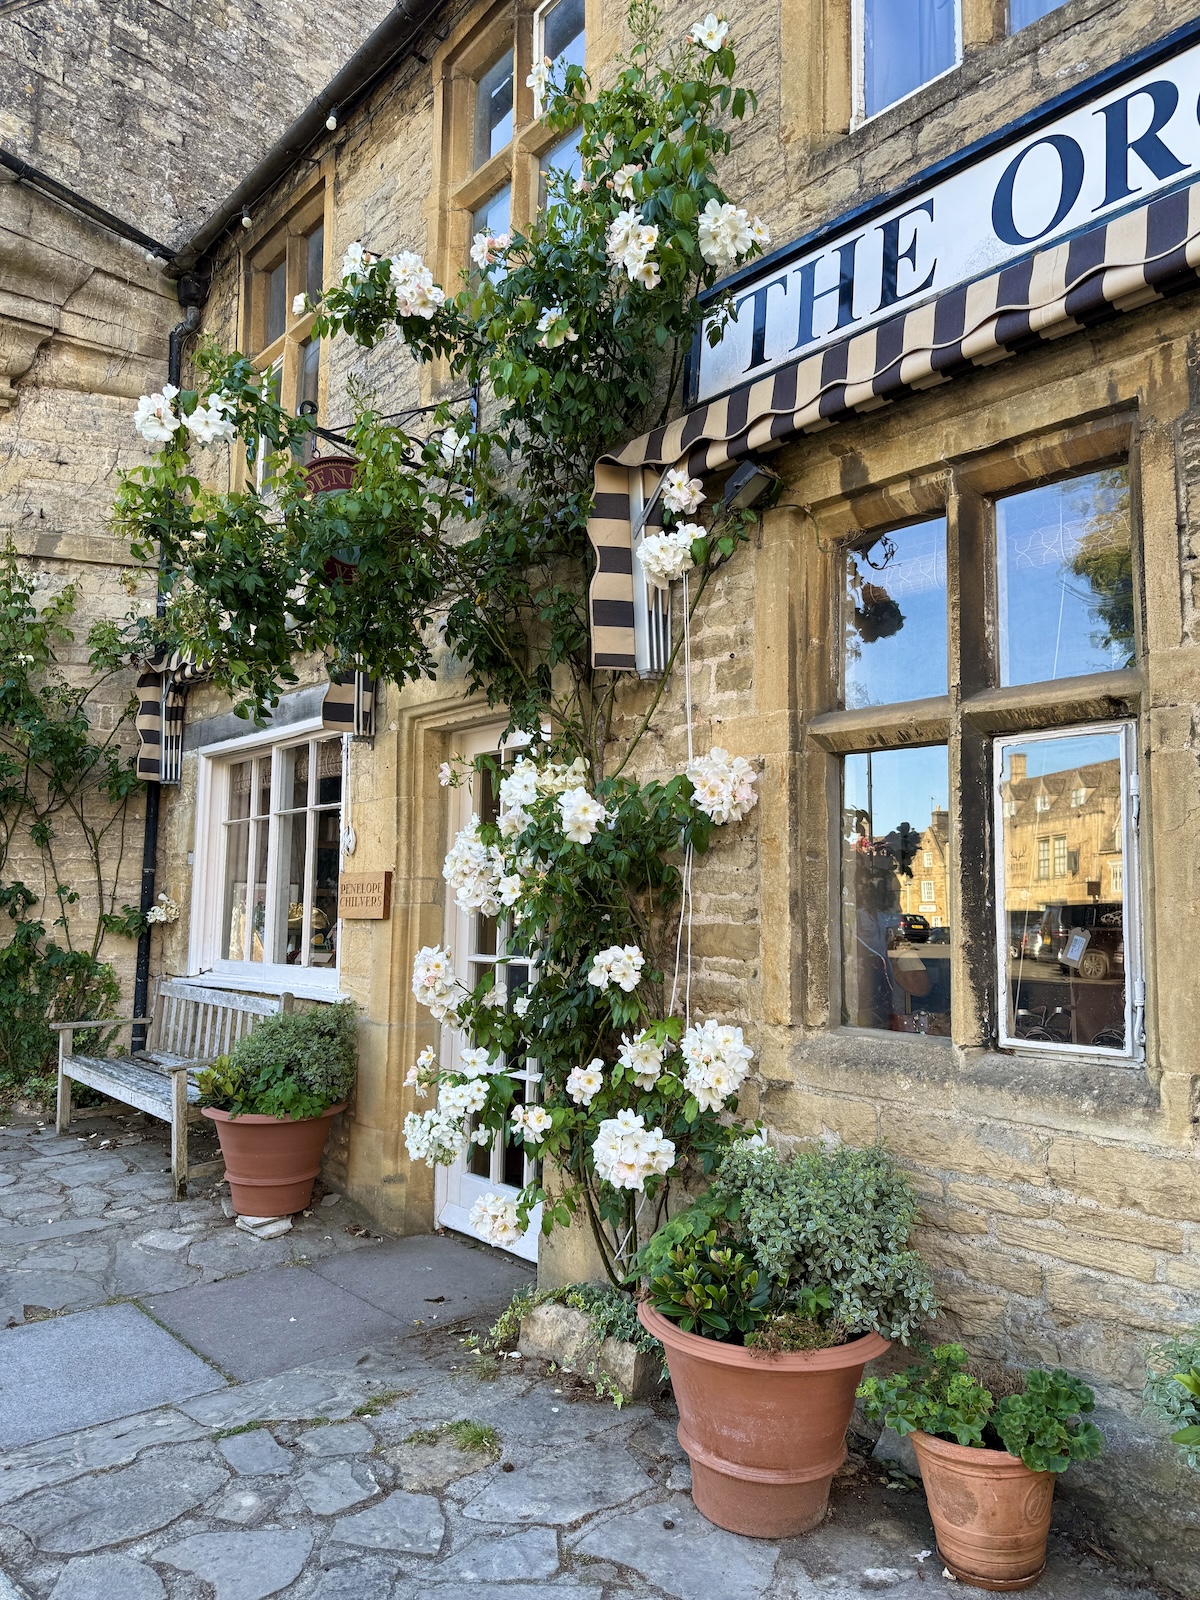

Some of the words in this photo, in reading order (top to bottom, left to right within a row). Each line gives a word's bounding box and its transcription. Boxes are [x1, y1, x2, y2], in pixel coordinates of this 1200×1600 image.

[735, 198, 938, 374] THE
[991, 79, 1200, 247] OR
[340, 882, 383, 895] PENELOPE
[340, 896, 382, 907] CHILVERS
